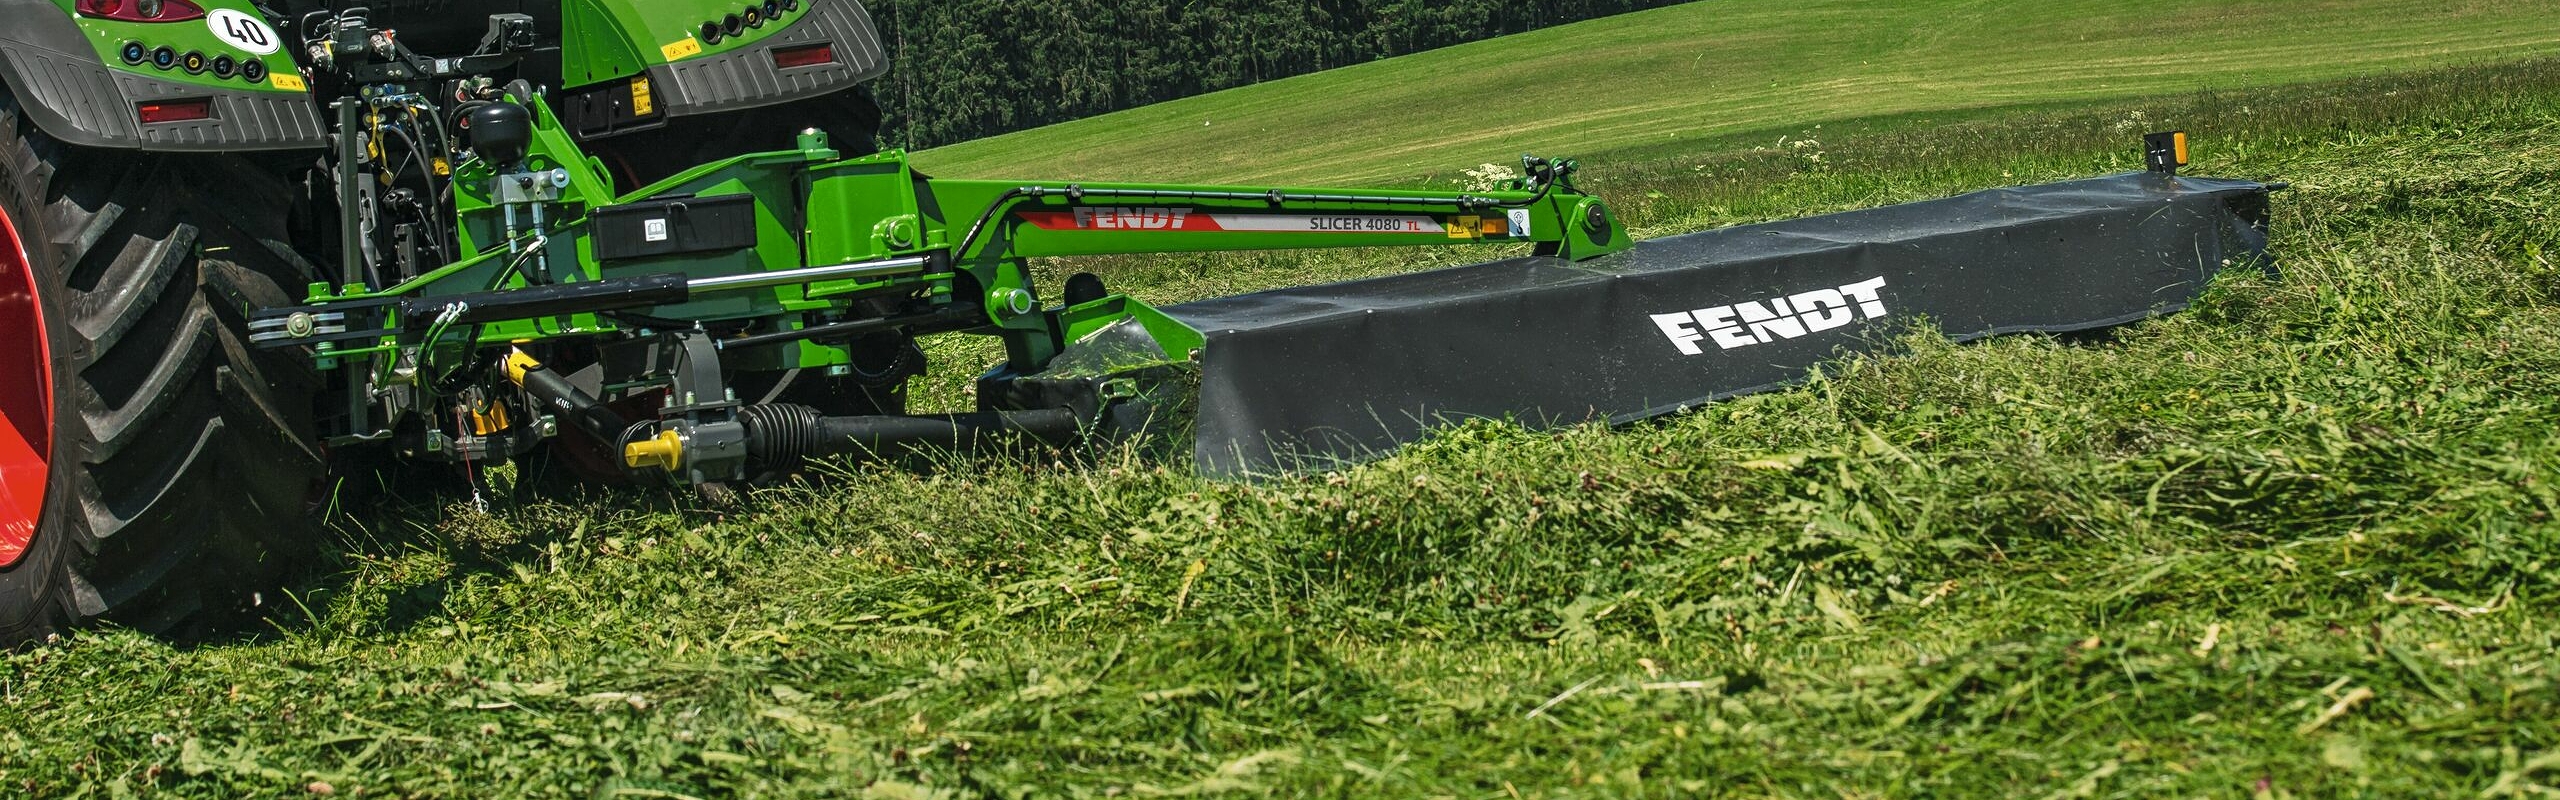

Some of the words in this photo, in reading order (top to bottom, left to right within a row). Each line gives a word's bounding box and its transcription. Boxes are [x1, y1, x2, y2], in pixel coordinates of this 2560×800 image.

[223, 16, 268, 46] 40
[1072, 206, 1193, 229] FENDT
[1310, 217, 1362, 231] SLICER
[1366, 218, 1401, 231] 4080
[1407, 221, 1421, 231] TL
[1649, 275, 1887, 356] FENDT
